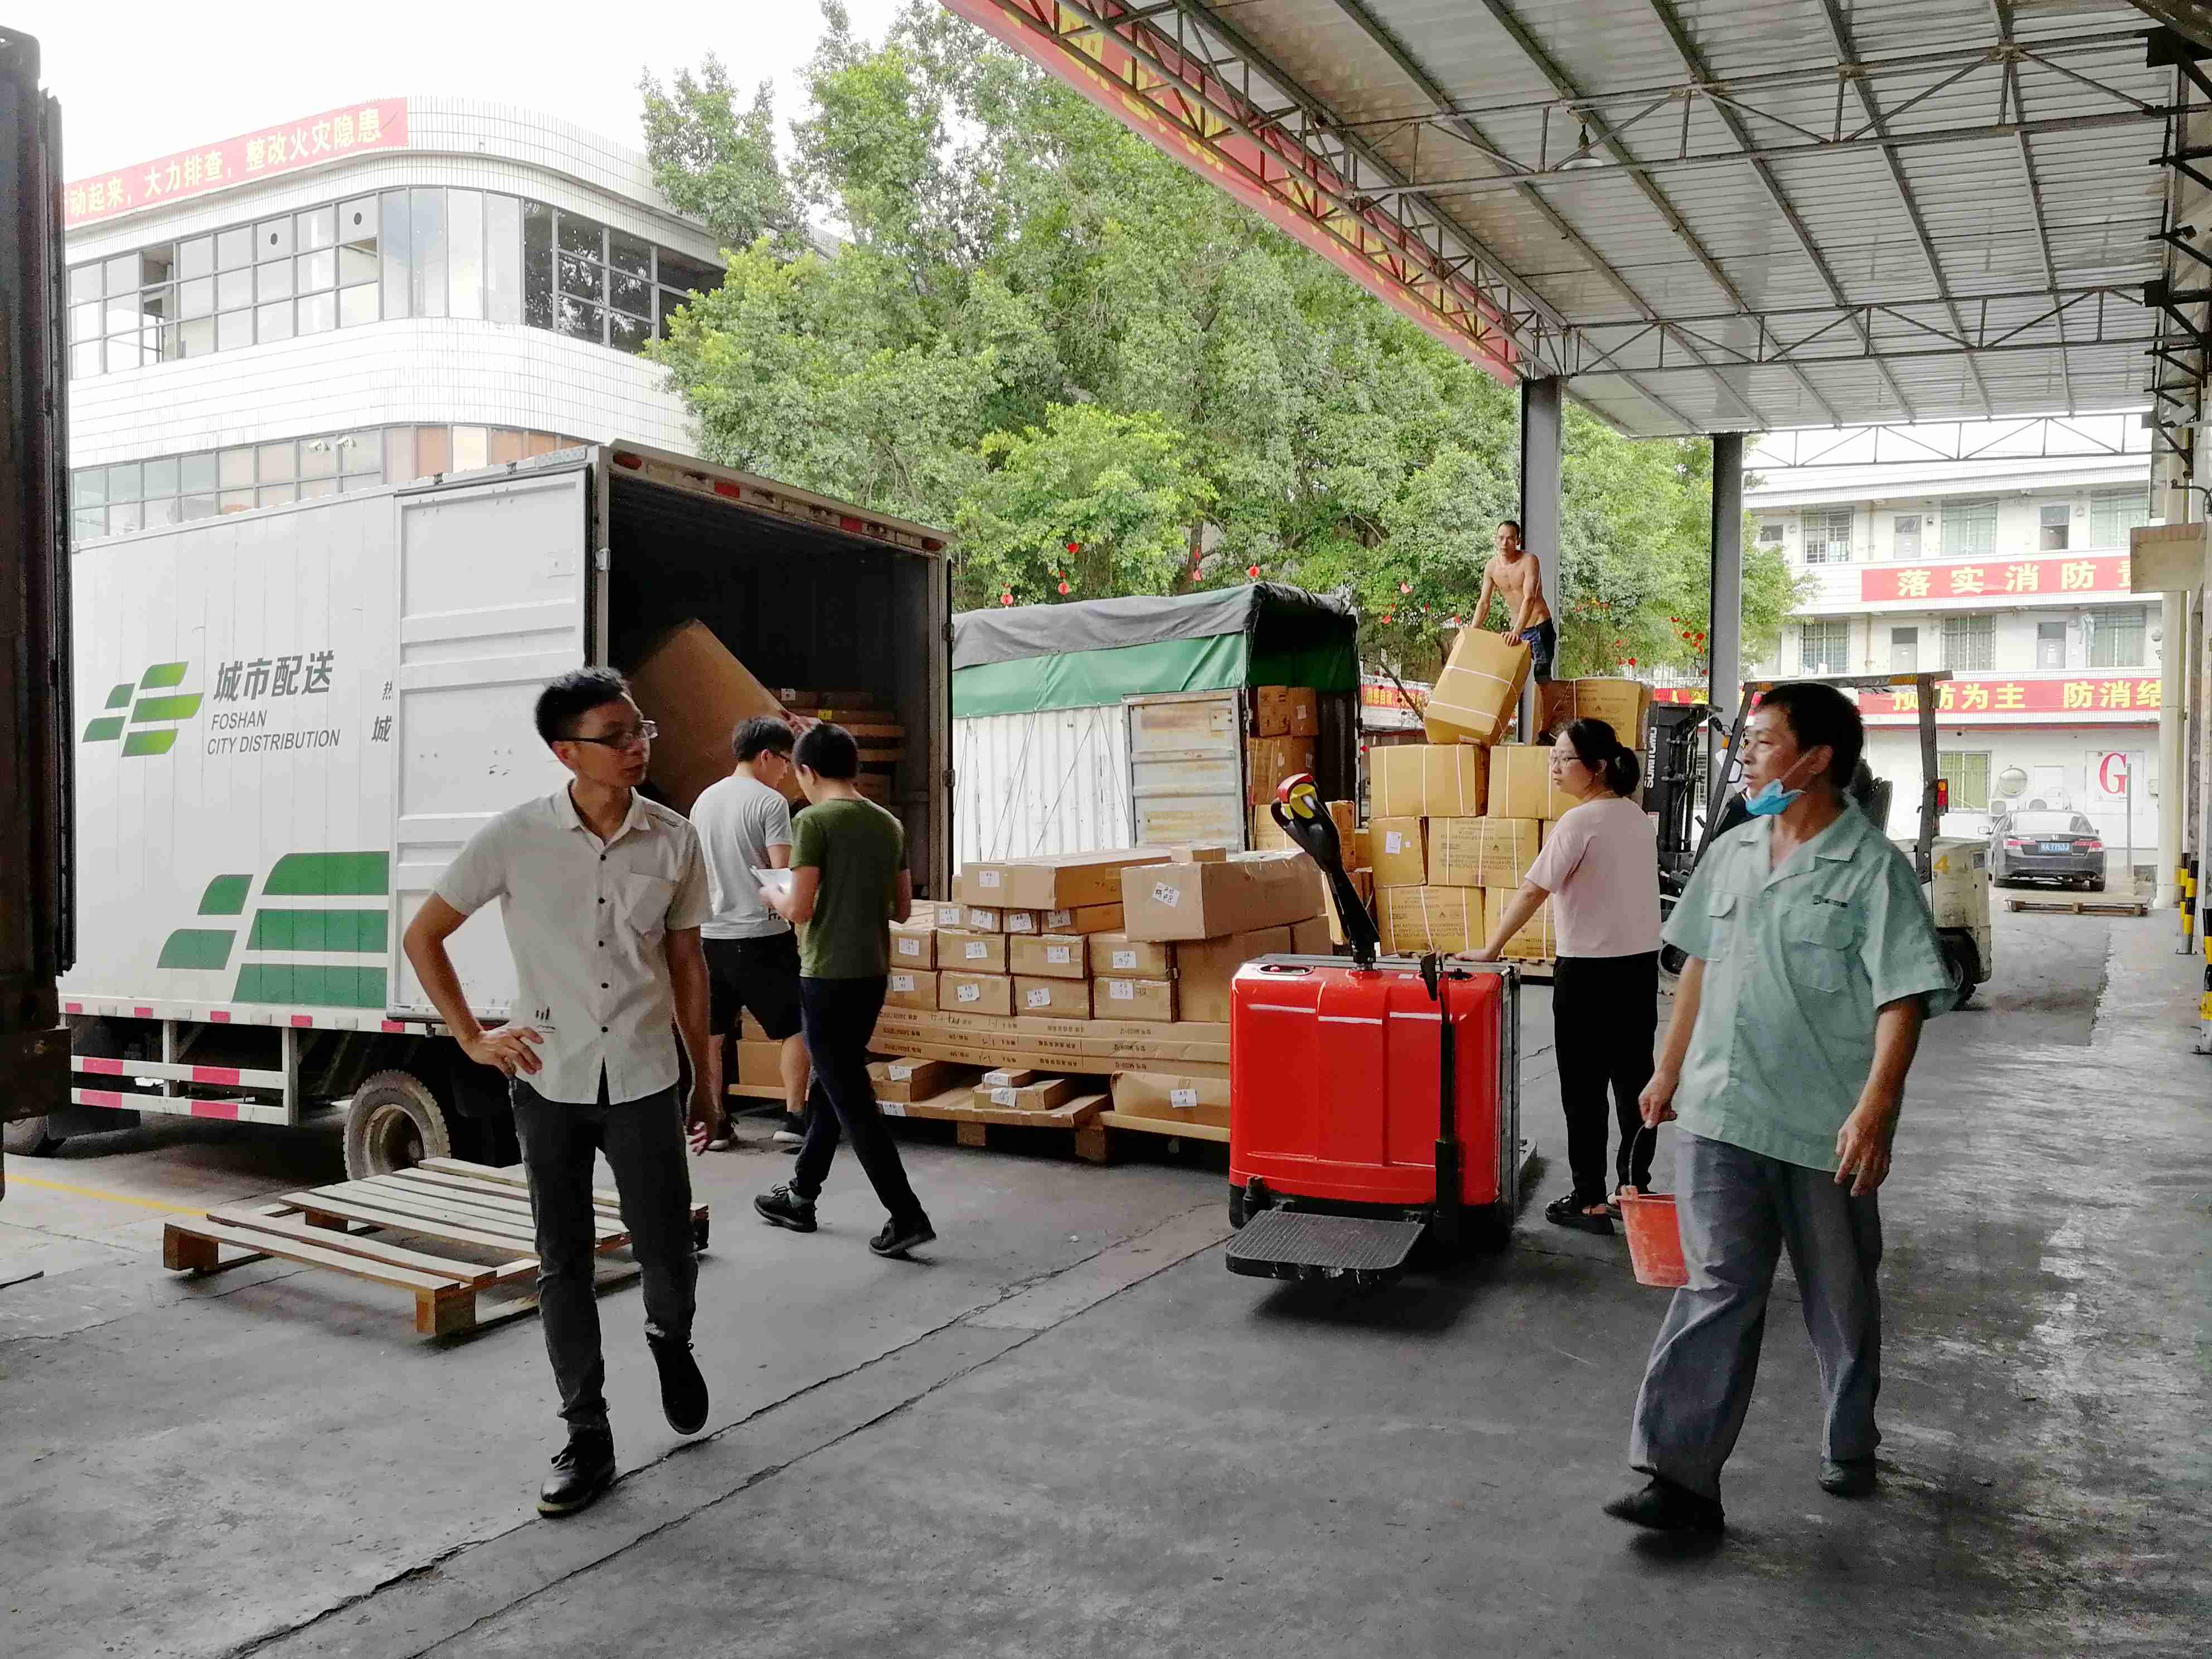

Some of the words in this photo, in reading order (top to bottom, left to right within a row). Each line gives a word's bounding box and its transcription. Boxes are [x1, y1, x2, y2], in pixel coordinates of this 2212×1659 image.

[213, 650, 334, 703] 城市配送
[211, 710, 268, 731] FOSHAN
[207, 737, 237, 755] CITY
[239, 729, 341, 753] DISTRIBUTION
[2099, 753, 2127, 794] G
[1934, 855, 1951, 875] 4
